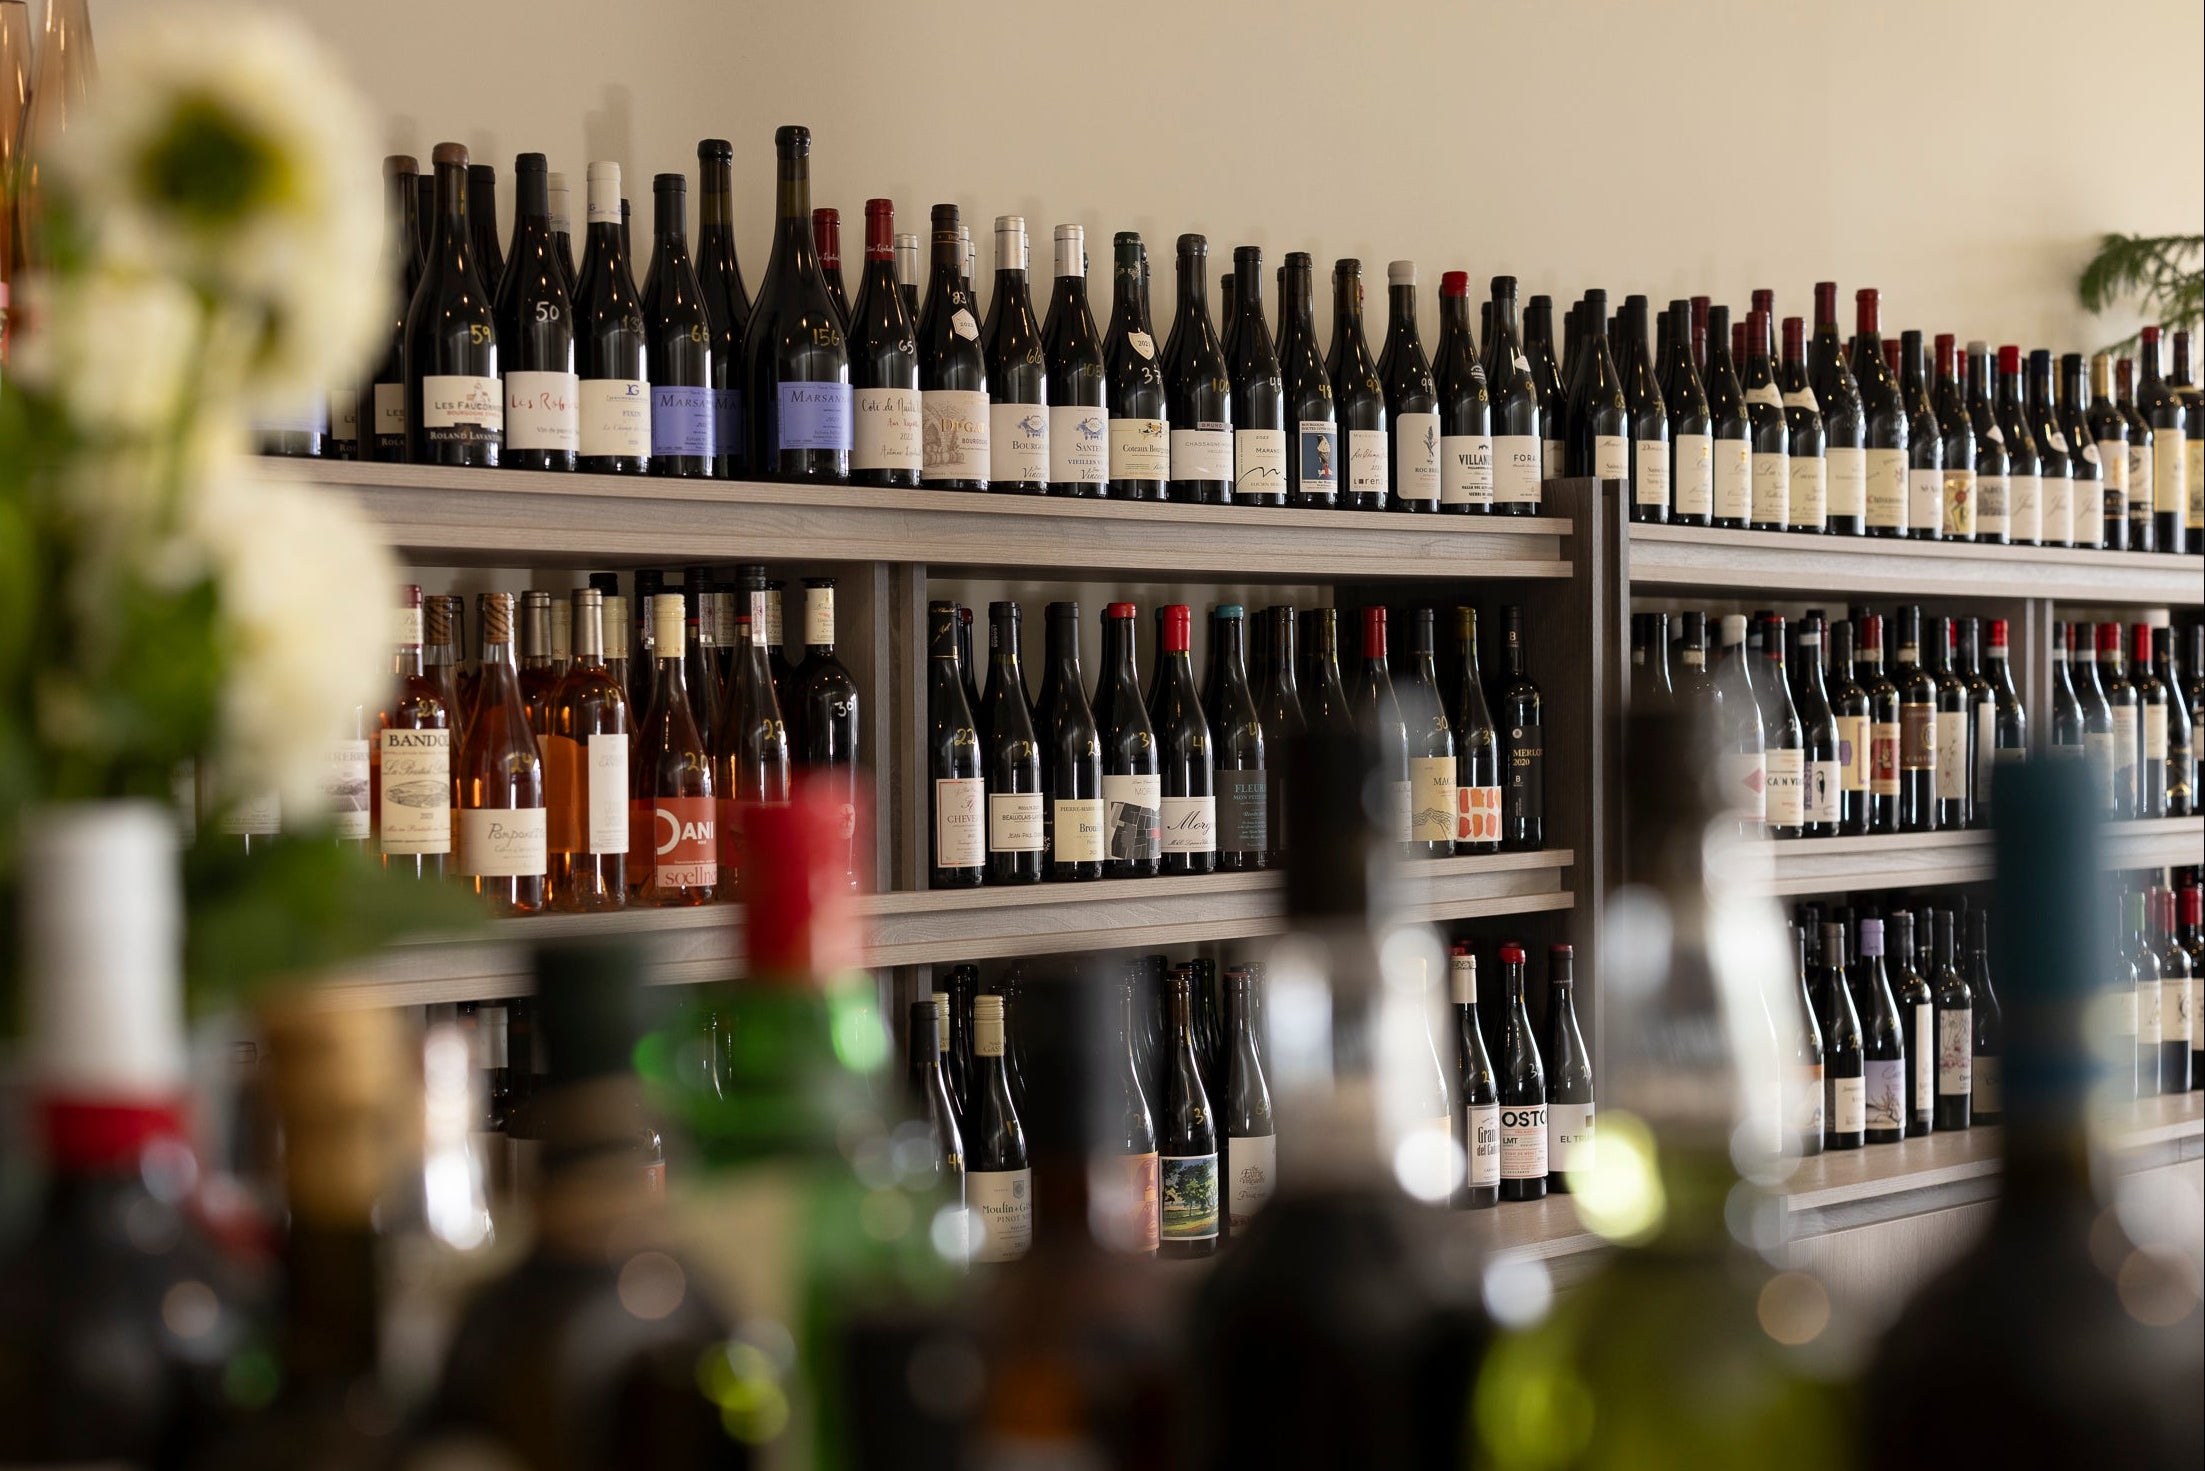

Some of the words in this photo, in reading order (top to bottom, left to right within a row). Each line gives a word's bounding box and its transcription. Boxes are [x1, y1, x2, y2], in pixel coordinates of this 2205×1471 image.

[536, 301, 559, 321] 50
[470, 324, 490, 344] 59
[812, 328, 840, 347] 156
[898, 339, 914, 355] 65
[1026, 347, 1041, 364] 66
[1141, 366, 1162, 384] 37
[434, 401, 454, 410] LES
[511, 394, 533, 409] Les
[430, 431, 466, 441] ROLAND
[1512, 758, 1531, 767] 2020
[1502, 1137, 1519, 1145] LMT
[1560, 1135, 1572, 1144] EL
